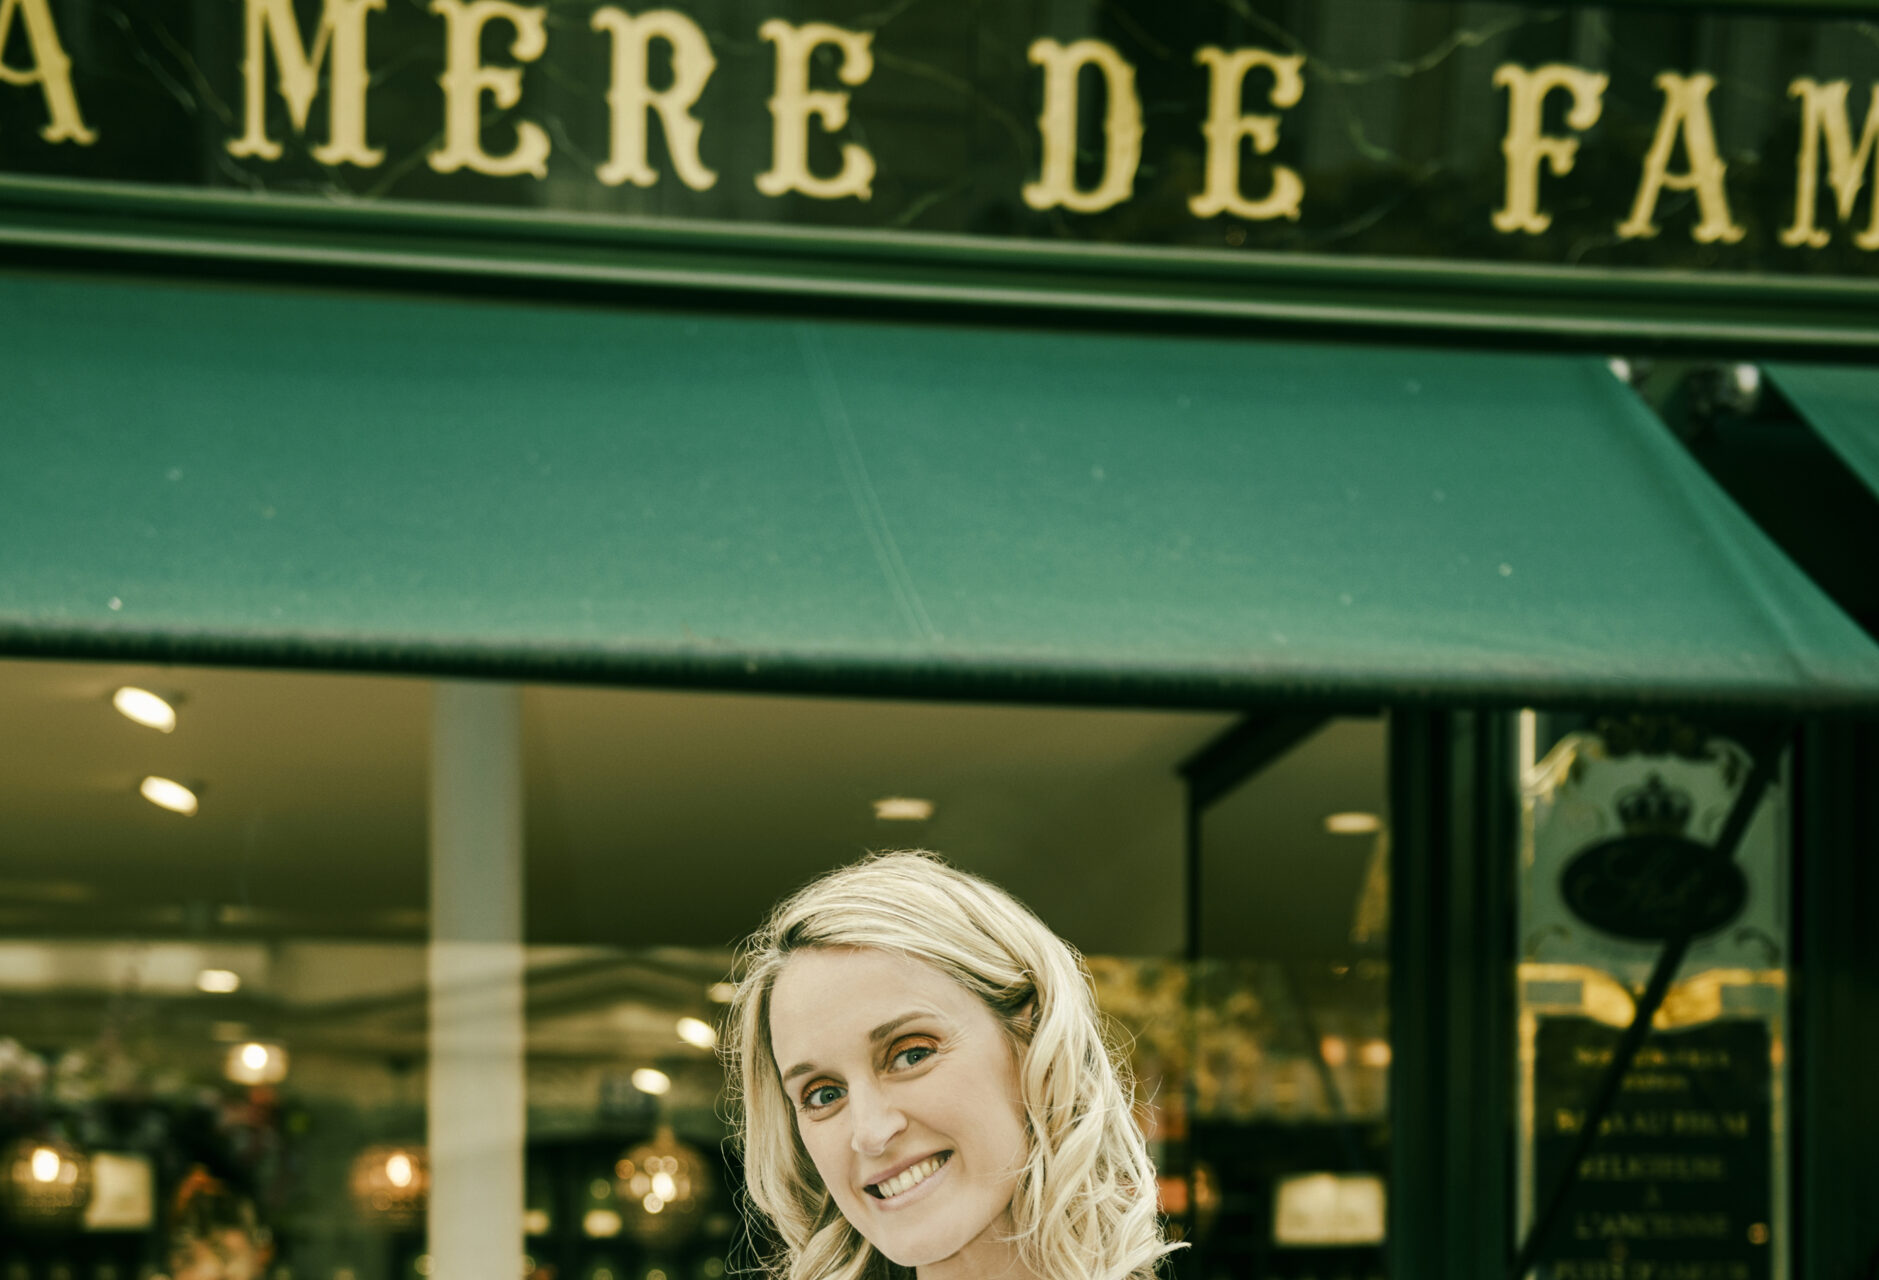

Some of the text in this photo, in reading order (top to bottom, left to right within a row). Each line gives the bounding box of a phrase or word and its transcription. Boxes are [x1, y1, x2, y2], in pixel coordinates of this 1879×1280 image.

[225, 0, 878, 201] MERE
[1022, 37, 1305, 221] DE
[1491, 62, 1879, 251] FAM
